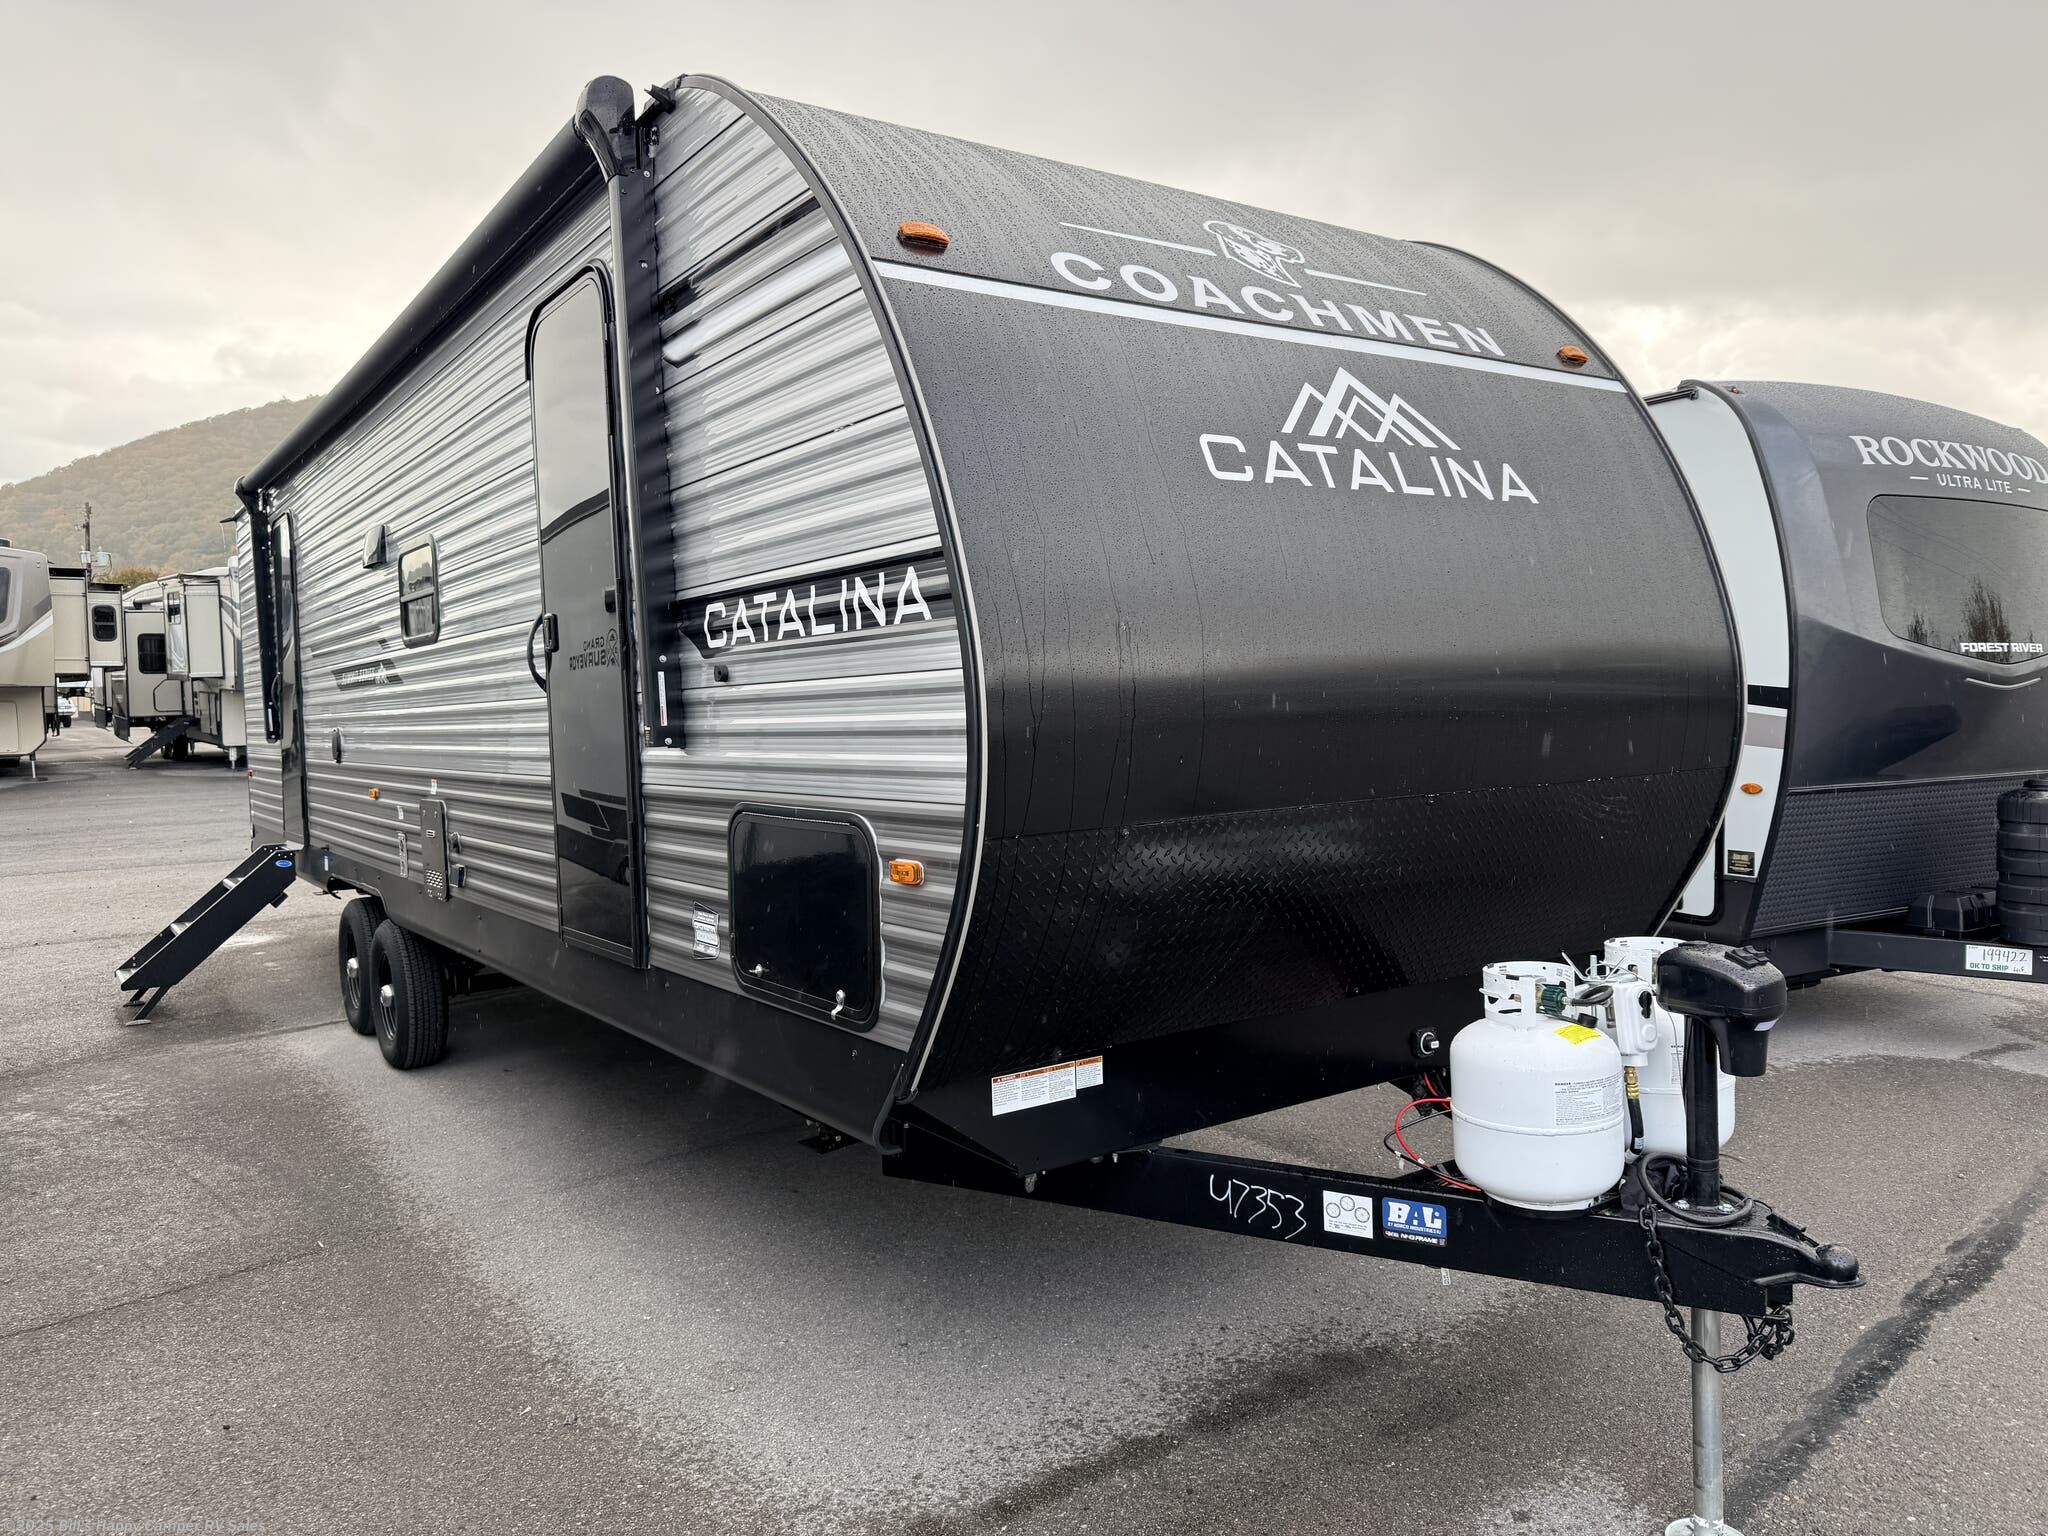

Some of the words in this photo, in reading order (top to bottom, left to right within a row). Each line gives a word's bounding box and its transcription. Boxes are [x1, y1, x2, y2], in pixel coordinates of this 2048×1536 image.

[1050, 251, 1505, 357] COACHMEN
[1199, 433, 1540, 504] CATALINA
[1848, 435, 2048, 485] ROCKWOOD
[1936, 473, 1983, 490] ULTRA
[1985, 478, 2013, 494] LITE
[703, 566, 932, 649] CATALINA
[1960, 642, 2009, 653] FOREST
[2010, 642, 2044, 653] RIVER
[1983, 948, 2027, 962] 199422
[1992, 964, 2009, 972] SHIP
[1209, 1173, 1307, 1240] 47353
